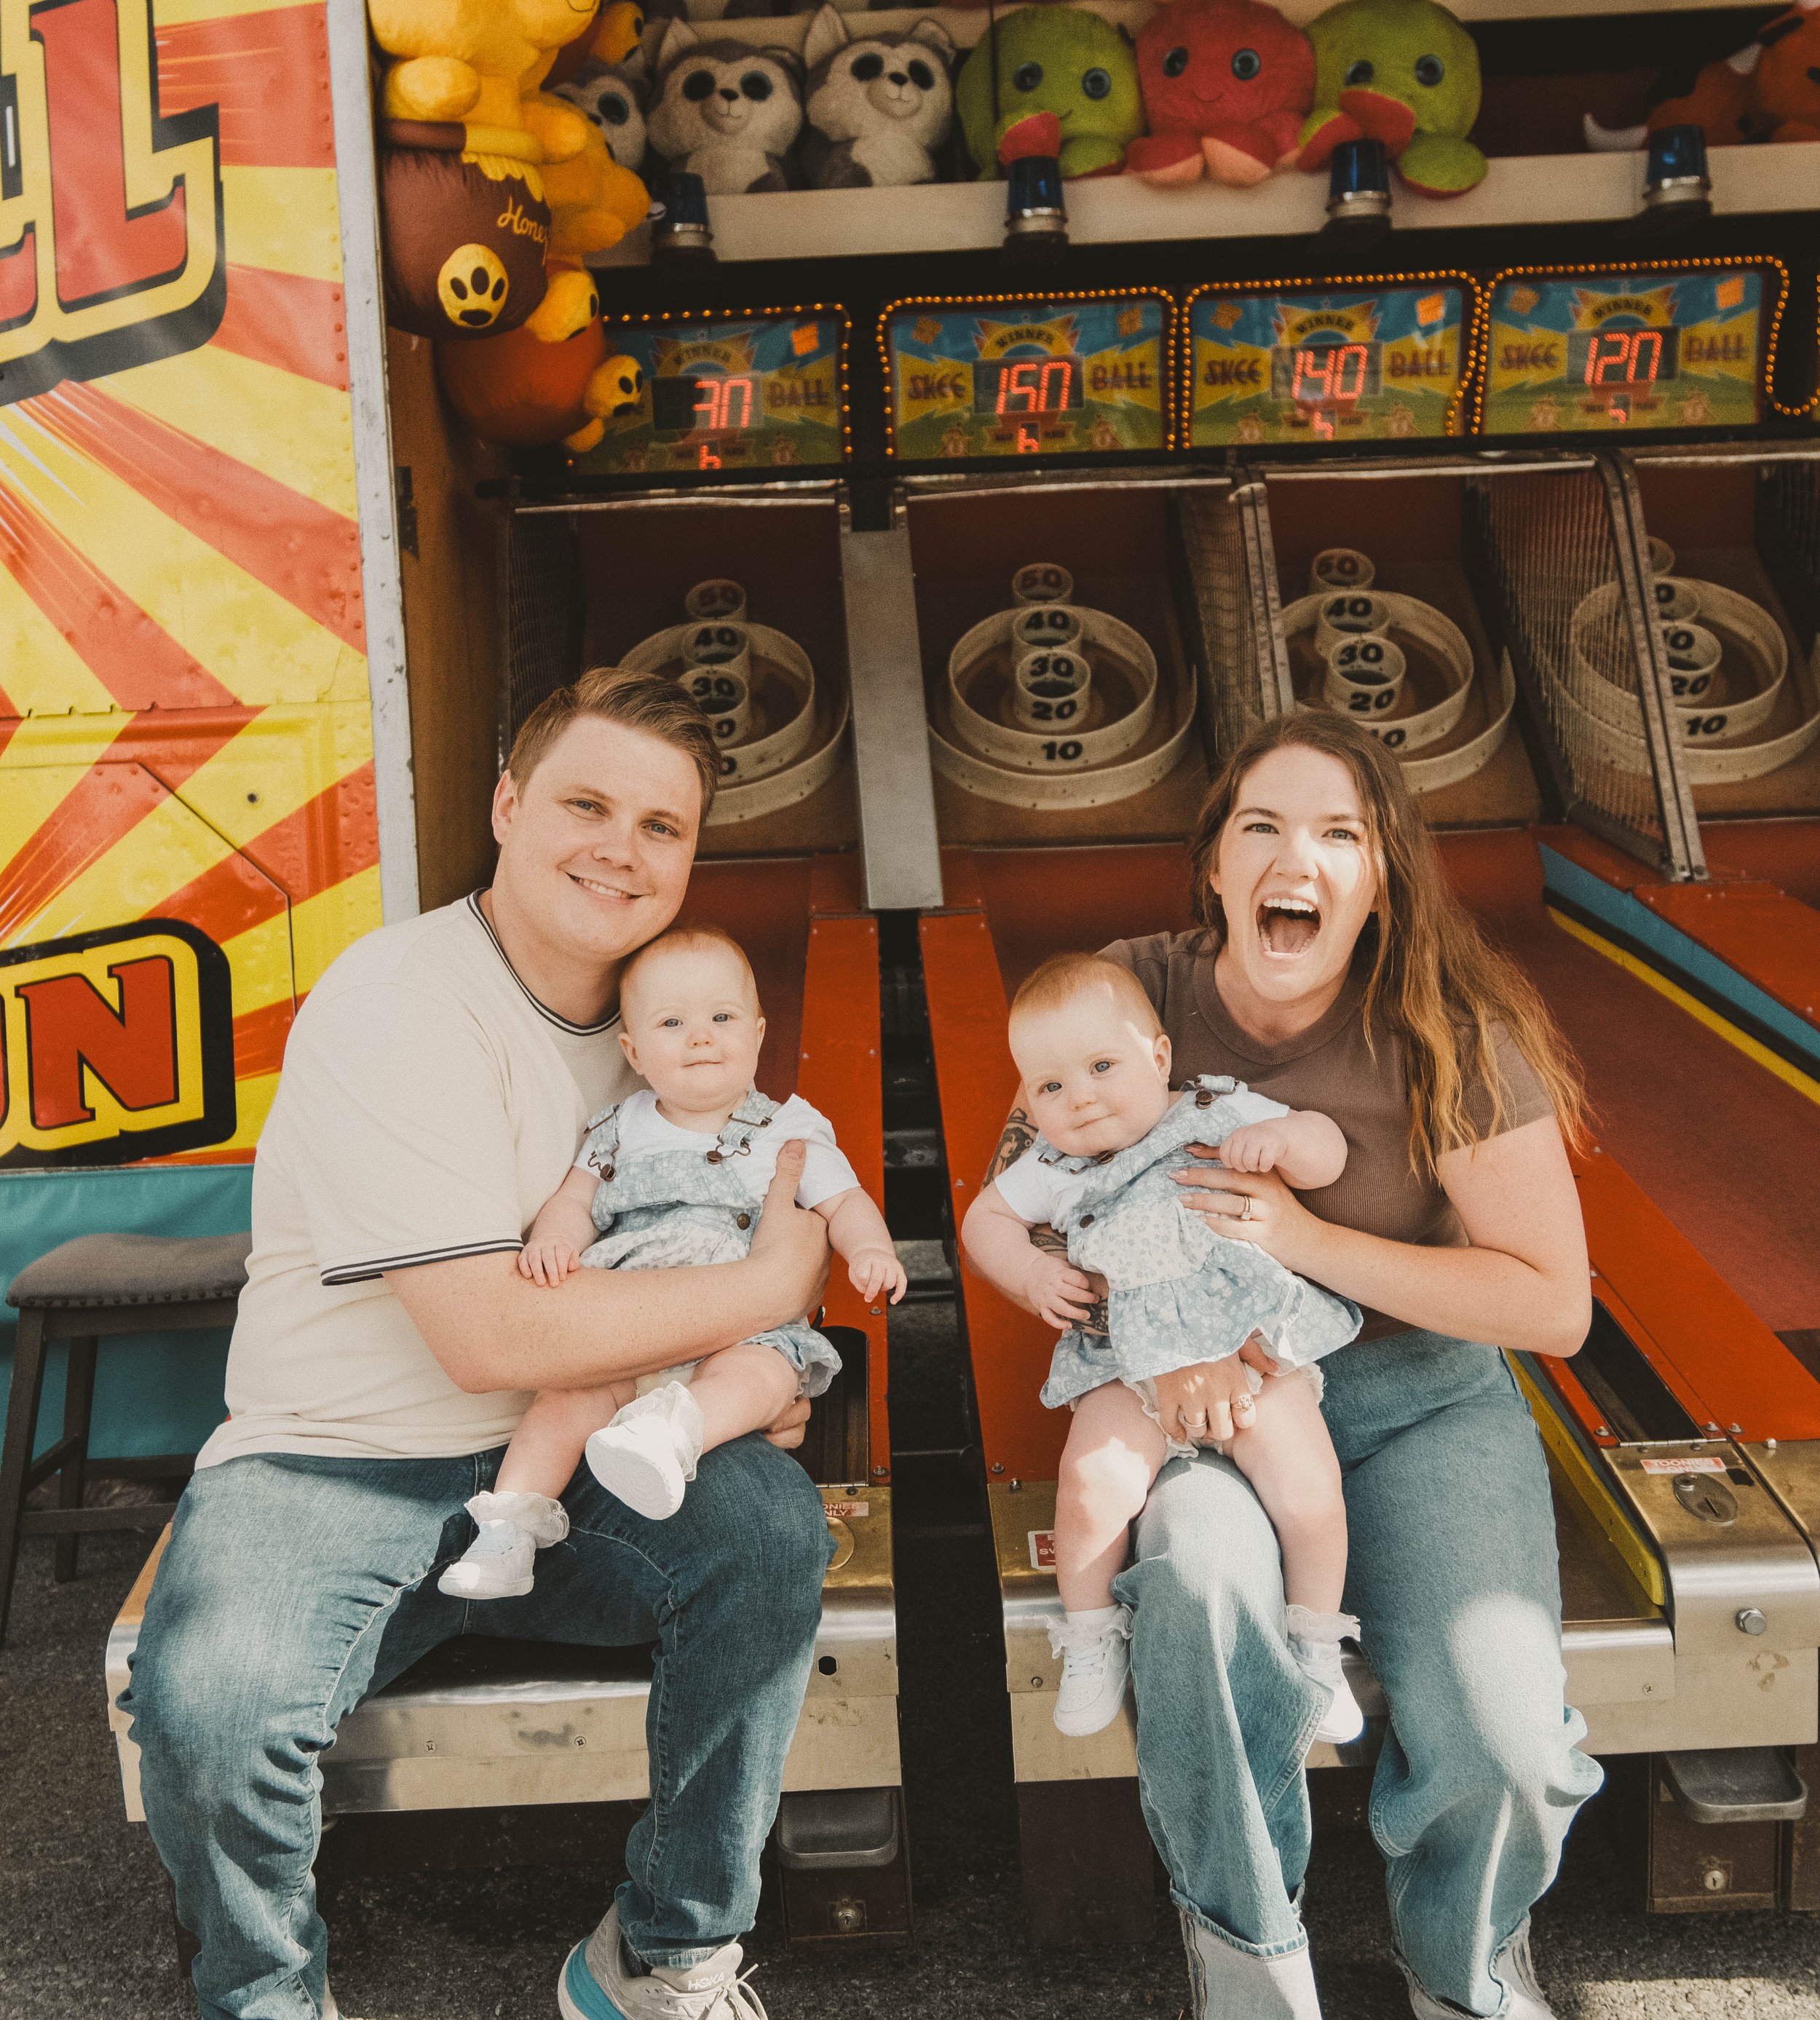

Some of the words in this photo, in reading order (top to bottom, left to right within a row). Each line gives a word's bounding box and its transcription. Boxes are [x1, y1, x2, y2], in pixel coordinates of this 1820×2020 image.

[1594, 296, 1653, 320] WINNER
[1294, 314, 1354, 333] WINNER
[995, 328, 1055, 348] WINNER
[1499, 343, 1559, 371] SKEE
[1685, 333, 1749, 364] BALL
[1583, 331, 1663, 386] 120
[1203, 357, 1262, 387] SKEE
[1388, 347, 1451, 378] BALL
[1291, 344, 1368, 400] 140
[908, 371, 968, 400] SKEE
[1089, 362, 1152, 392] BALL
[996, 361, 1072, 415] 150
[768, 378, 830, 409] BALL
[1326, 595, 1374, 618] 40
[1025, 609, 1069, 630] 40
[694, 627, 737, 648] 40
[1337, 641, 1385, 666] 30
[1029, 655, 1075, 678] 30
[692, 676, 736, 697] 30
[1032, 699, 1078, 721] 20
[1349, 687, 1396, 712] 20
[1685, 713, 1729, 736] 10
[1042, 740, 1085, 761] 10
[688, 1971, 726, 1991] HOKA
